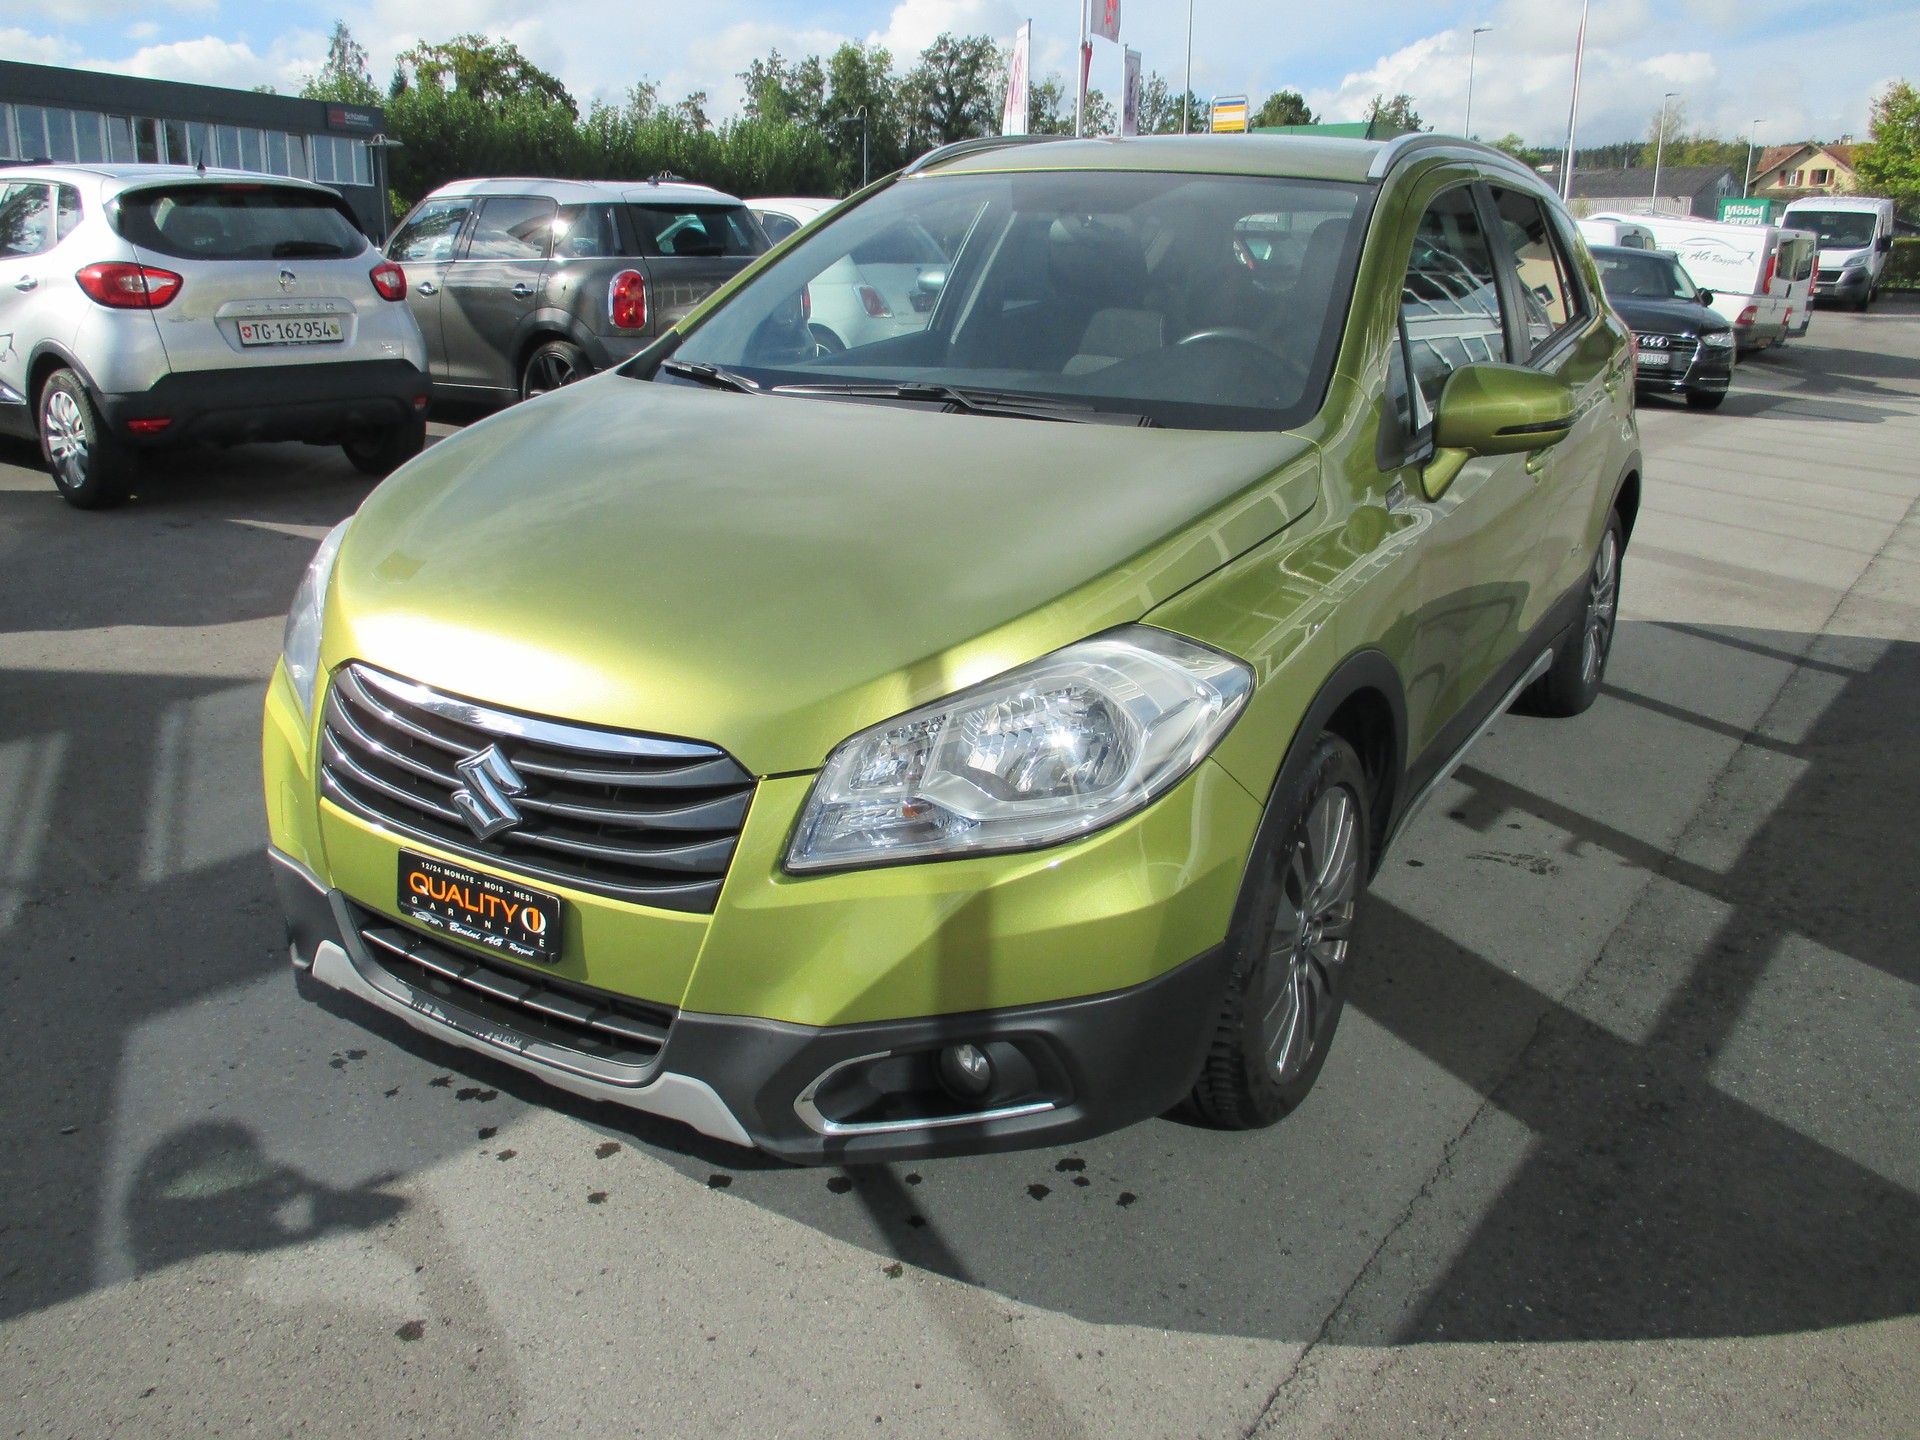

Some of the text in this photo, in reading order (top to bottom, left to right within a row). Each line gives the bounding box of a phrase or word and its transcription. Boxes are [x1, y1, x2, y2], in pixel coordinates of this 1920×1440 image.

[1724, 204, 1764, 216] Möbel
[1723, 216, 1762, 225] Ferrari
[1689, 250, 1710, 262] AG
[246, 302, 335, 312] CAPTUR
[421, 862, 441, 874] 12/24
[444, 868, 475, 884] MONATE
[484, 881, 504, 894] MOIS
[514, 890, 533, 903] MESI
[409, 871, 519, 923] QUALITY
[411, 895, 545, 948] GARANTIE
[449, 921, 481, 940] Benini
[484, 934, 503, 948] AG
